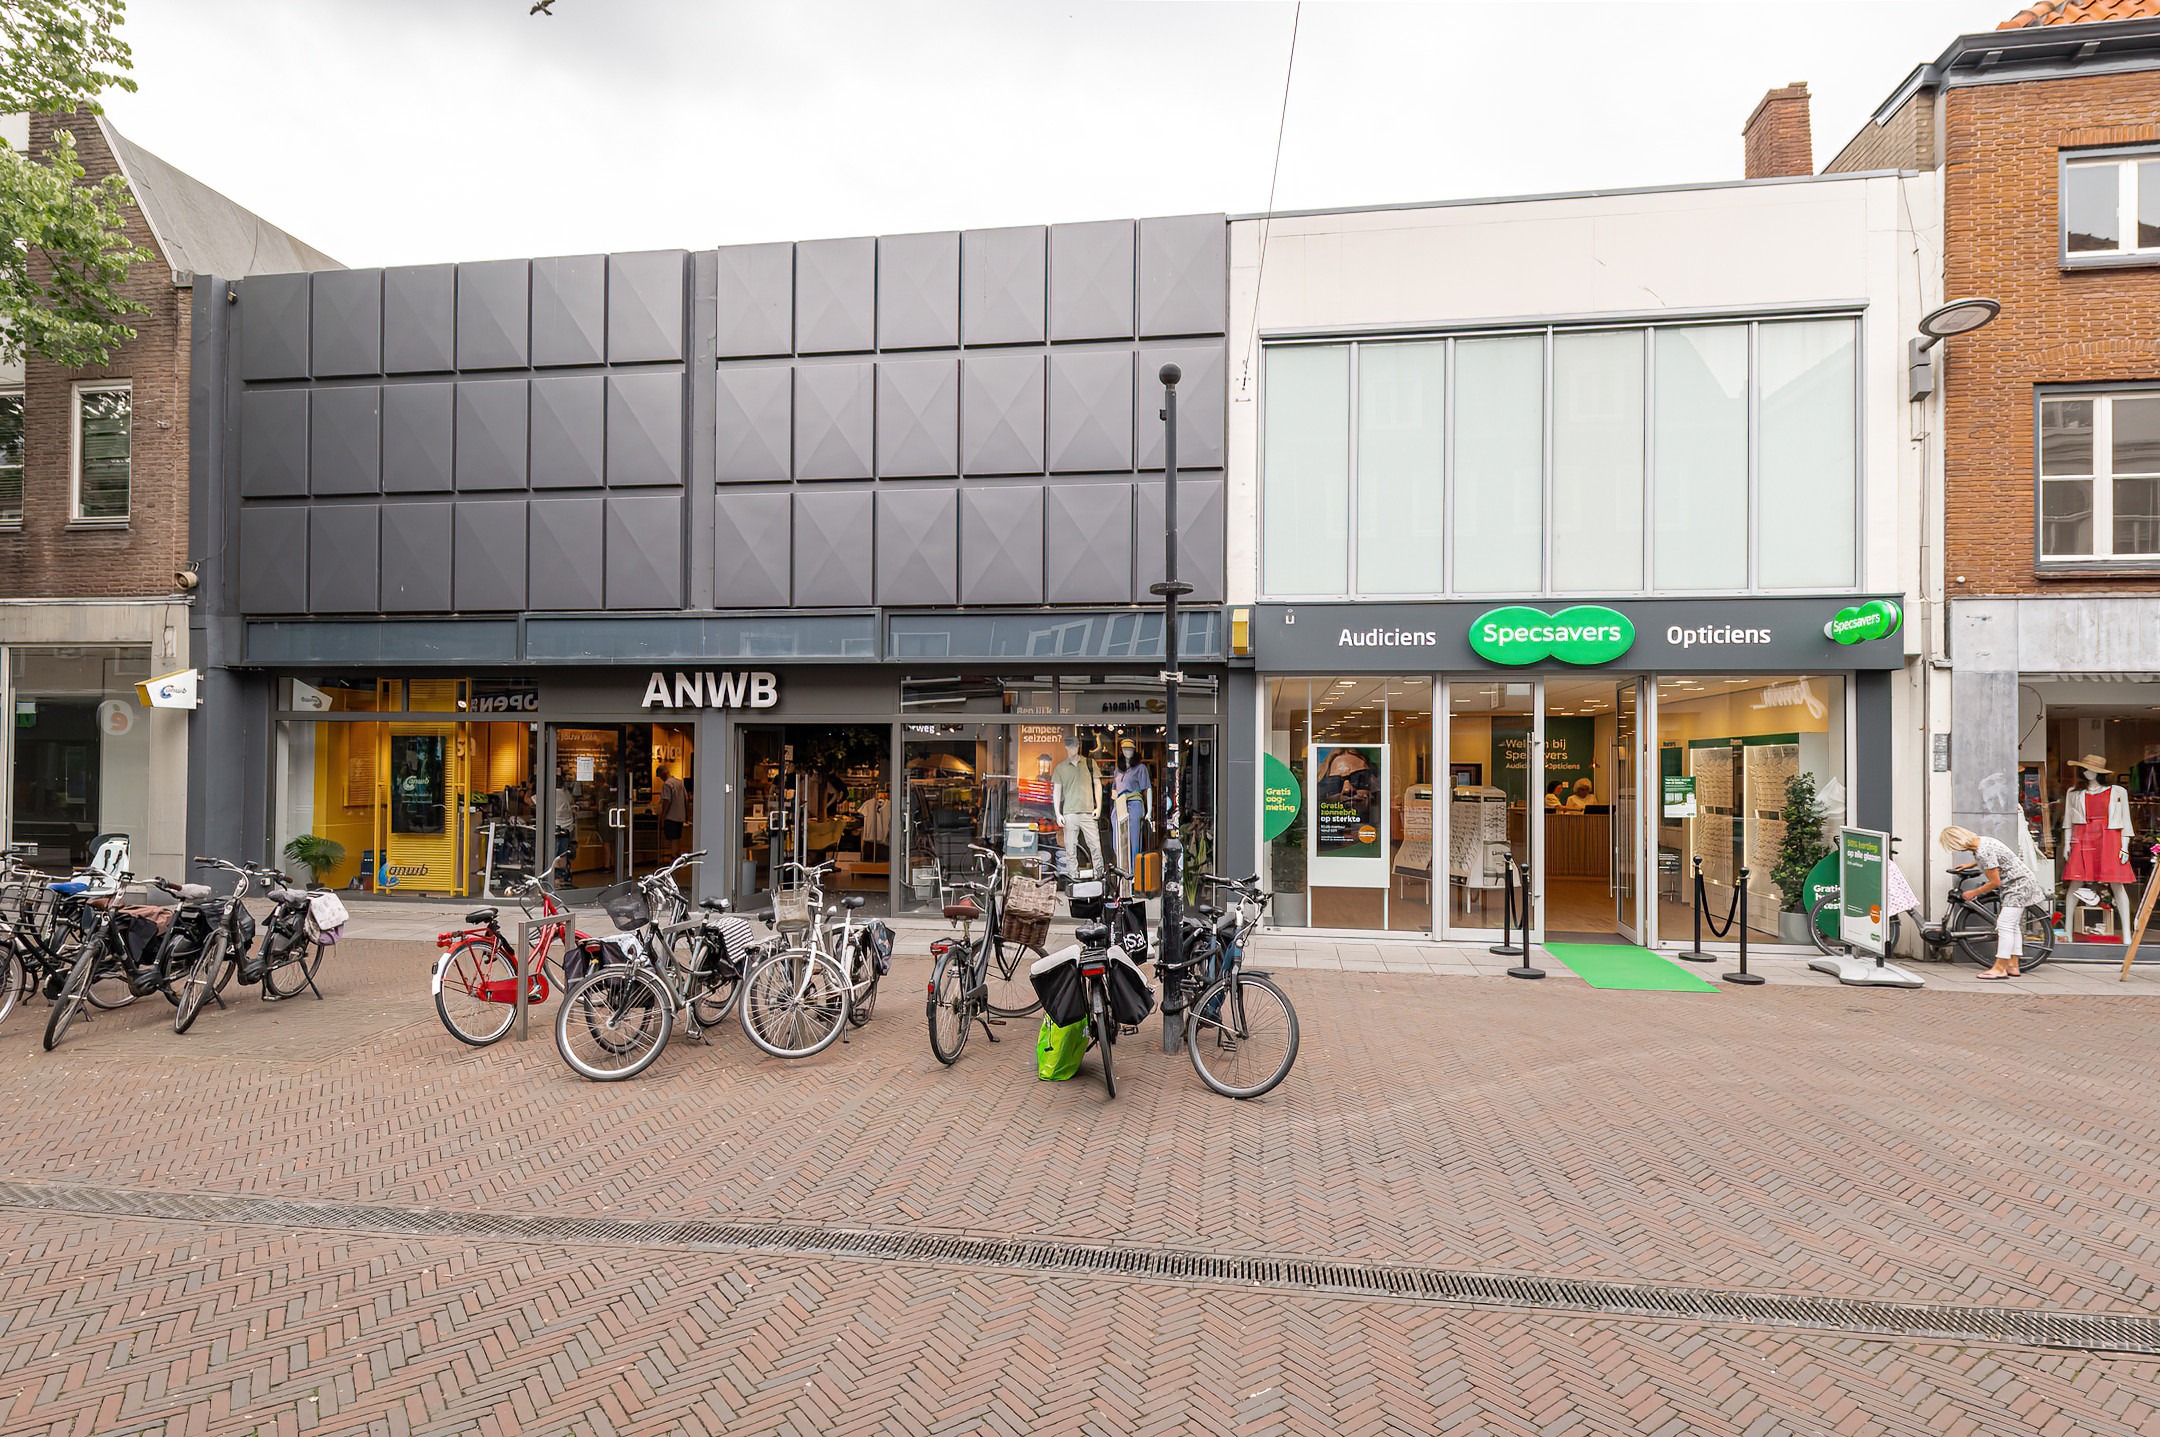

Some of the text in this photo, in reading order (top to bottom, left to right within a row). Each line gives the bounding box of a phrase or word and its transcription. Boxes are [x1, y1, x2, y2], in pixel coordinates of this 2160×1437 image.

[1833, 613, 1880, 634] Specsavers
[1338, 628, 1437, 647] Audiciens
[1483, 623, 1621, 646] Specsavers
[1667, 625, 1772, 648] Opticiens
[641, 671, 778, 708] ANWB
[1021, 725, 1064, 735] kampeer-
[1023, 734, 1062, 743] seizoen?
[1552, 739, 1566, 750] bij
[1505, 750, 1568, 761] Spevers
[1265, 787, 1291, 796] Gratis
[1265, 796, 1286, 805] oog-
[1320, 802, 1344, 810] Gratis
[1265, 803, 1296, 813] meting
[1332, 815, 1361, 823] sterkte
[388, 864, 429, 876] anwb
